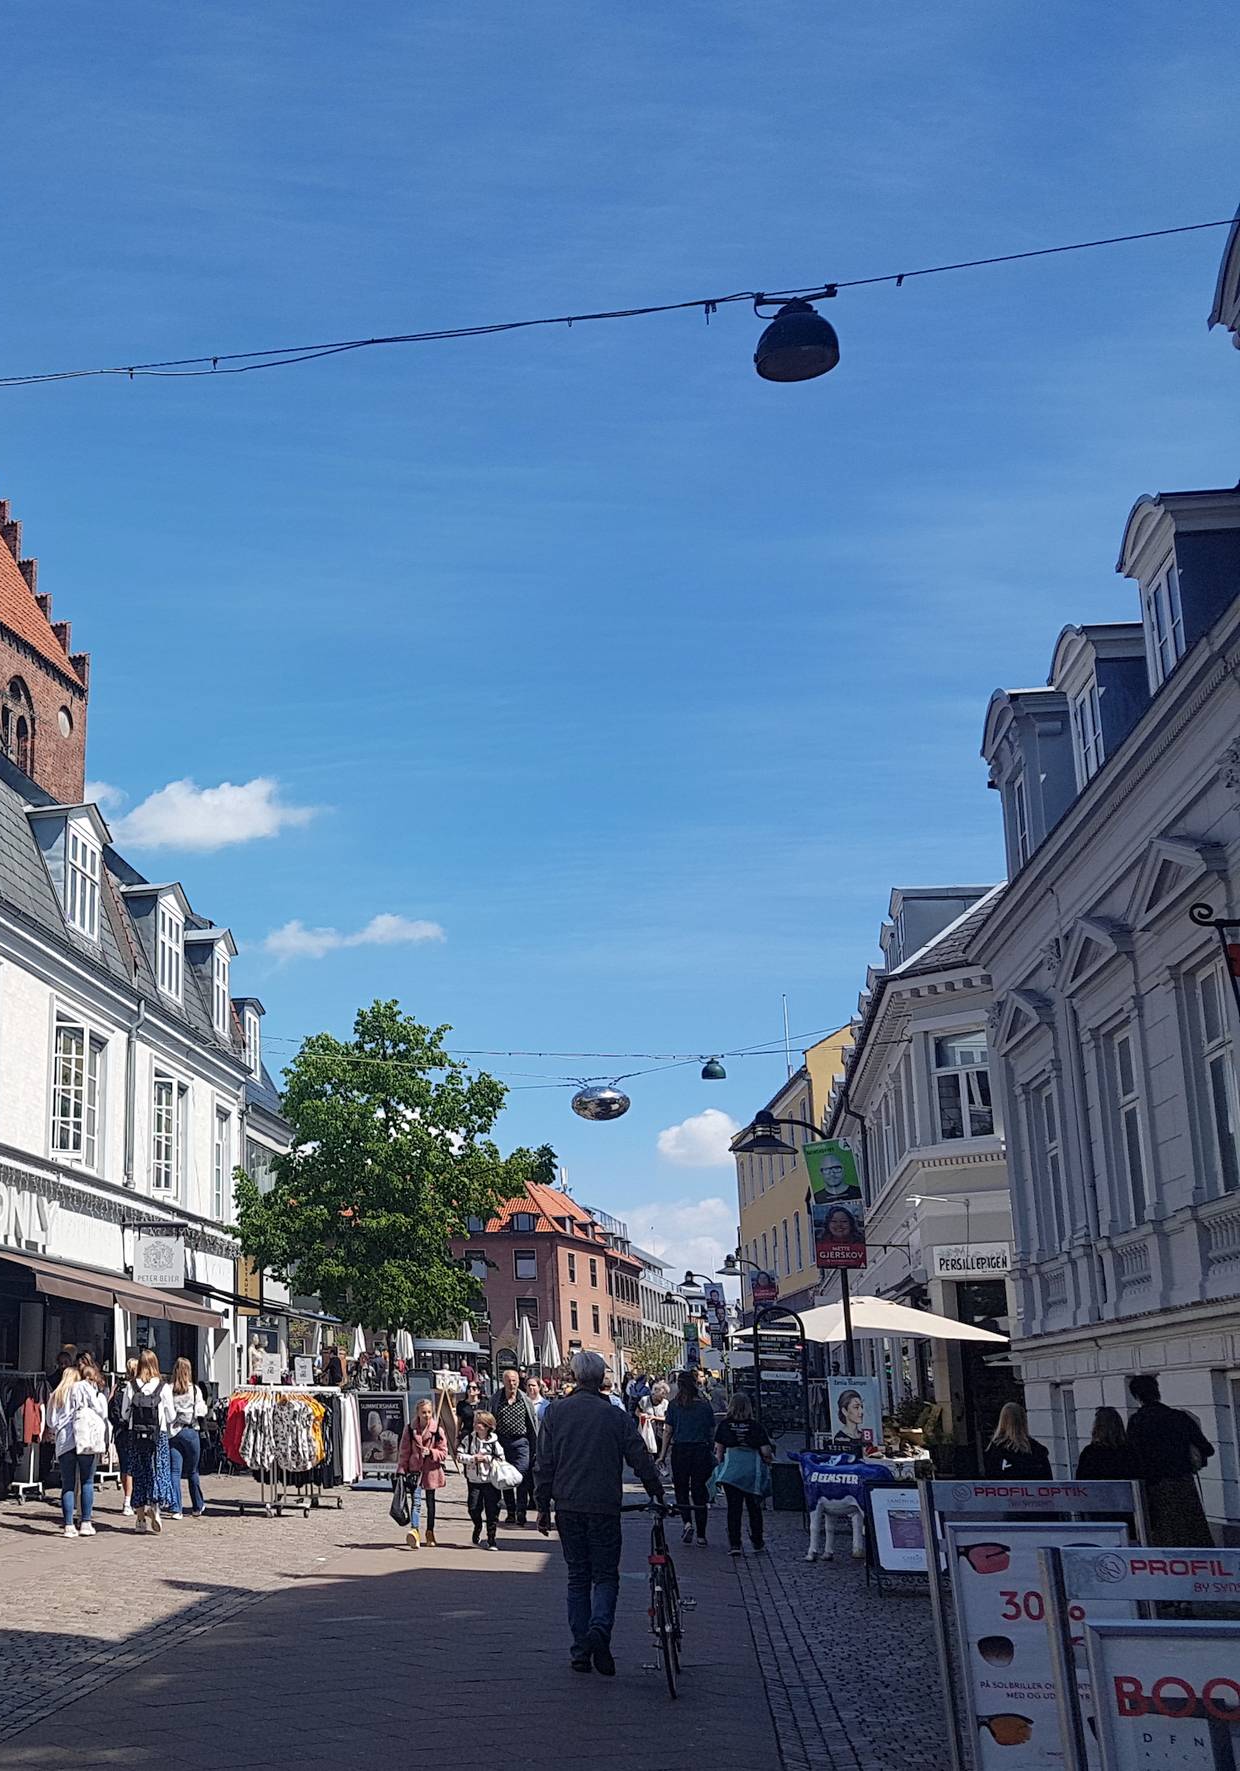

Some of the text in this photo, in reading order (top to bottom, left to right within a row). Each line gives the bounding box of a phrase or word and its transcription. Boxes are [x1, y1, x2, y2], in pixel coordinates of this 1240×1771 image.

[819, 1251, 864, 1259] GJERSKOV
[939, 1256, 1008, 1271] PERSILLEPIGEN
[811, 1472, 859, 1485] BEEMSTER
[974, 1487, 1088, 1497] PROFIL OPTIK
[1130, 1559, 1234, 1577] PROFIL
[1193, 1582, 1210, 1593] BY
[980, 1680, 991, 1689] PÅ
[1006, 1692, 1026, 1700] MED
